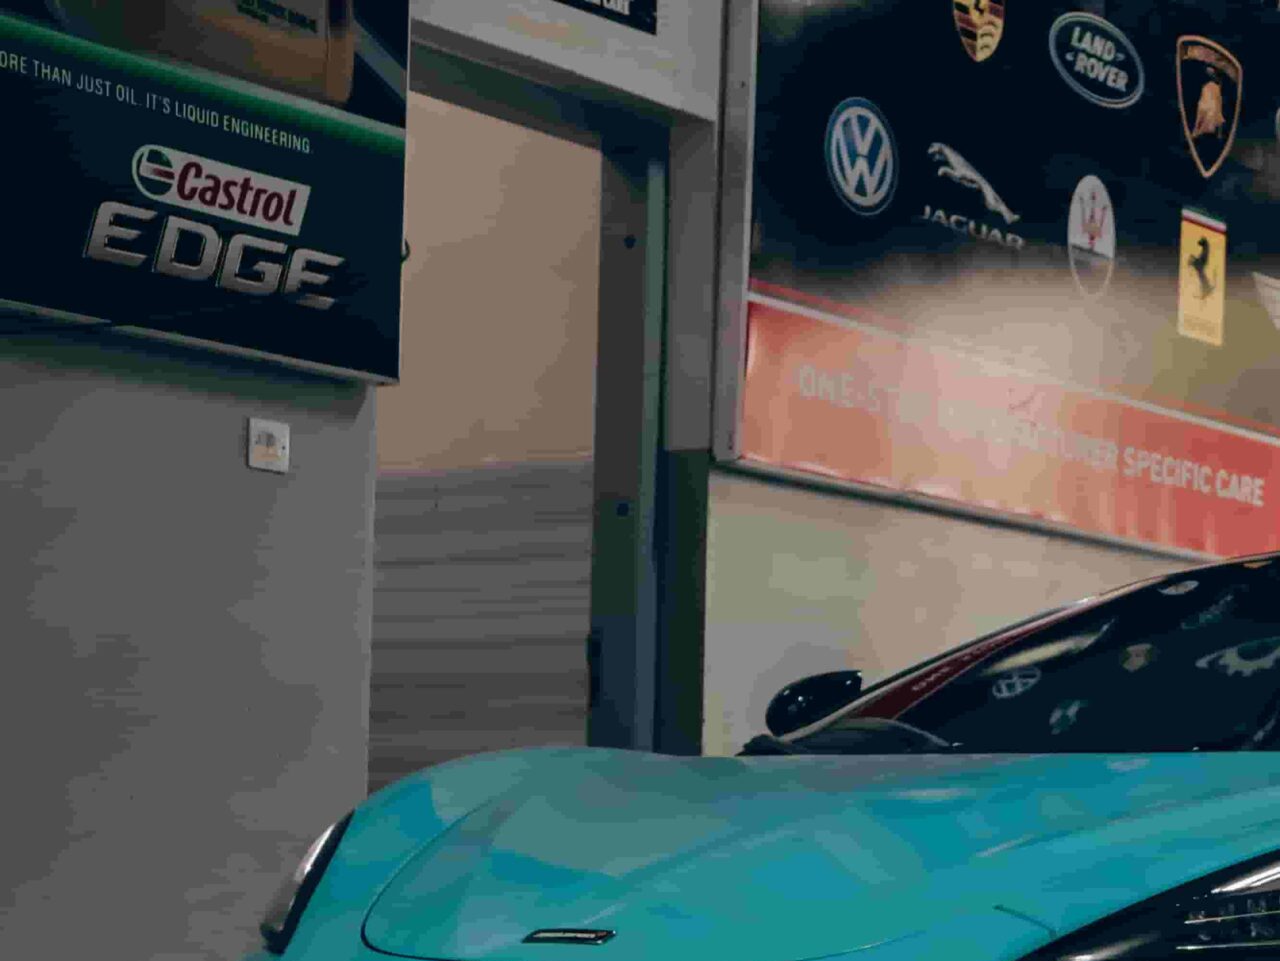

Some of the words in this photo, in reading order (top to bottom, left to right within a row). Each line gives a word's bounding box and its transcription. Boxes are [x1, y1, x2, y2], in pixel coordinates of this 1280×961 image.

[1070, 26, 1116, 61] LAND
[1074, 51, 1129, 92] ROVER
[32, 59, 72, 87] THAN
[77, 73, 112, 97] JUST
[116, 84, 143, 106] OIL.
[146, 92, 170, 115] IT'S
[175, 101, 219, 128] LIQUID
[223, 114, 314, 155] ENGINEERING.
[176, 160, 298, 227] Castrol
[84, 200, 346, 311] EDGE
[921, 204, 1025, 249] JAGUAR
[1123, 446, 1213, 494] SPECIFIC
[1215, 469, 1265, 508] CARE
